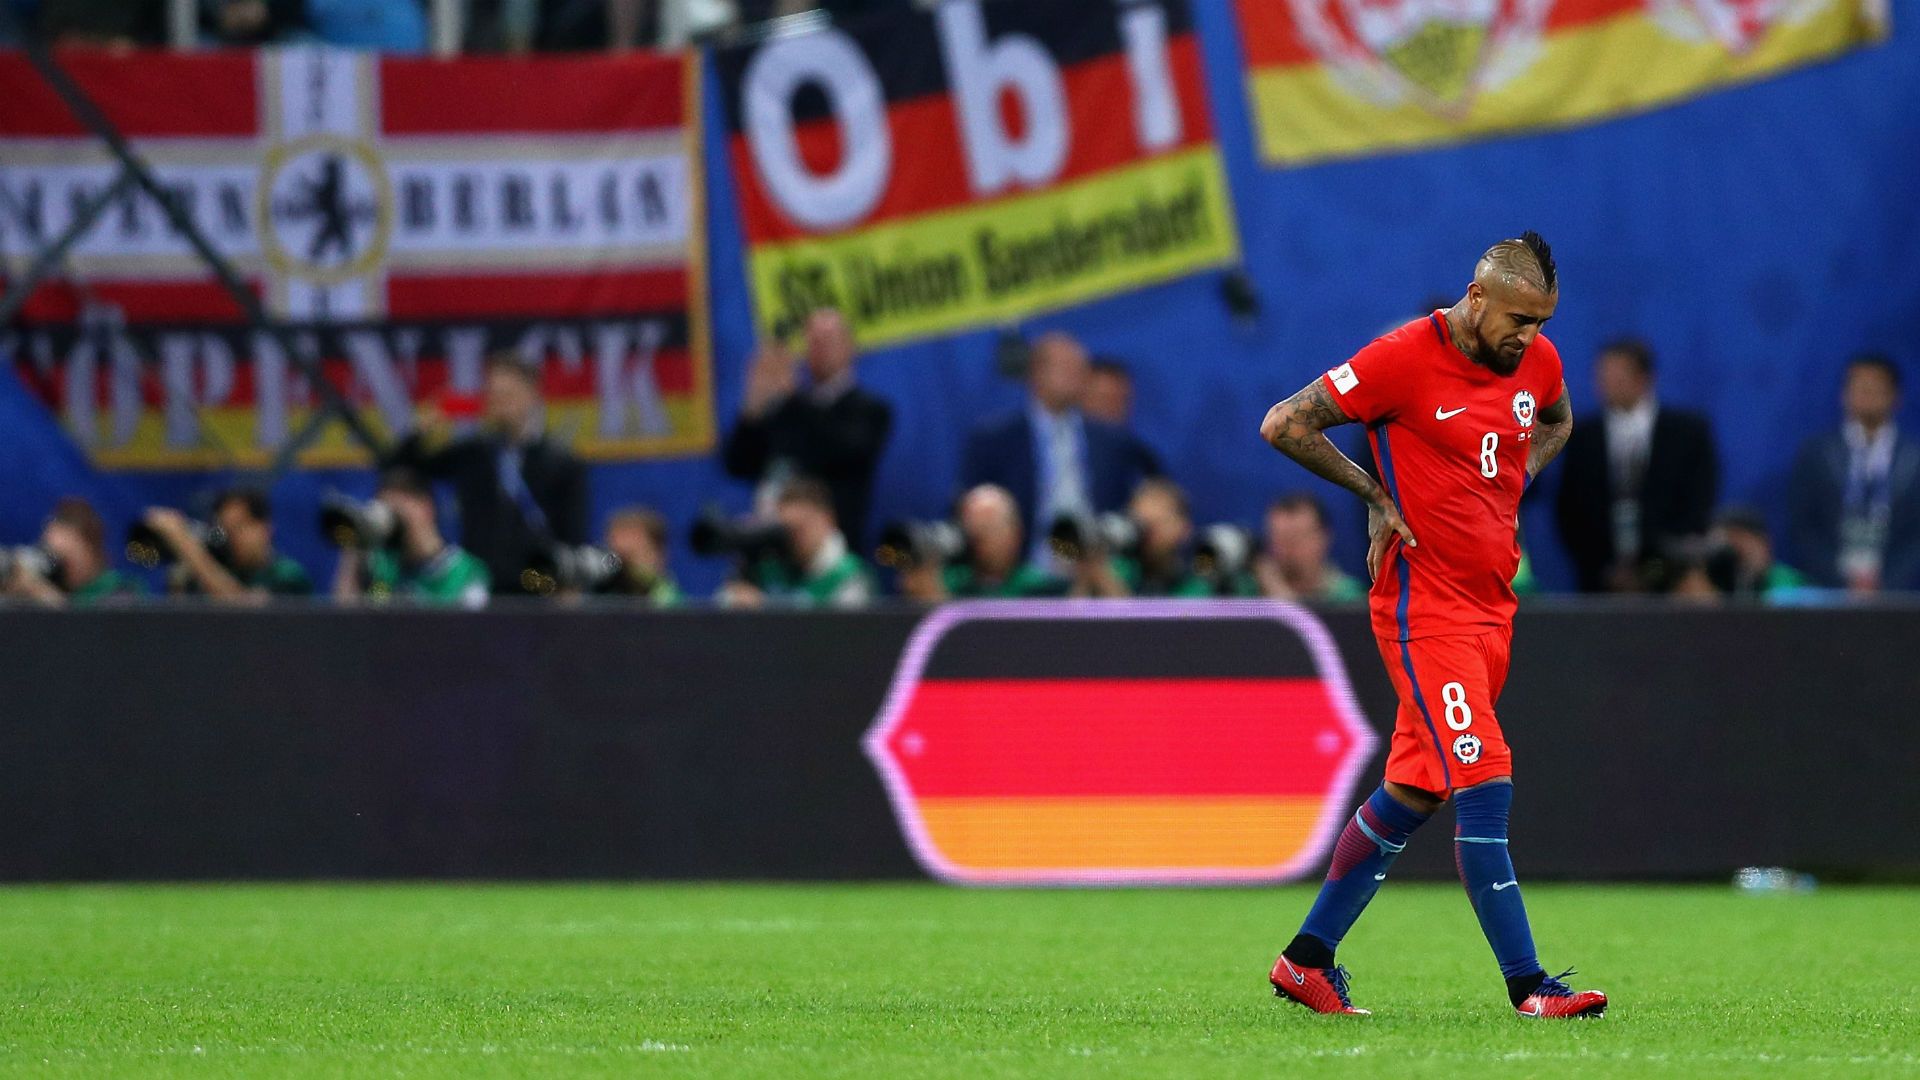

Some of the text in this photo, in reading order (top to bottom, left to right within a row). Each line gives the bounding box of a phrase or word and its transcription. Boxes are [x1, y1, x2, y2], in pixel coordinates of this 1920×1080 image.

[402, 170, 670, 234] BERLIN
[847, 248, 968, 322] Union
[1480, 432, 1499, 479] 8
[1441, 681, 1473, 731] 8
